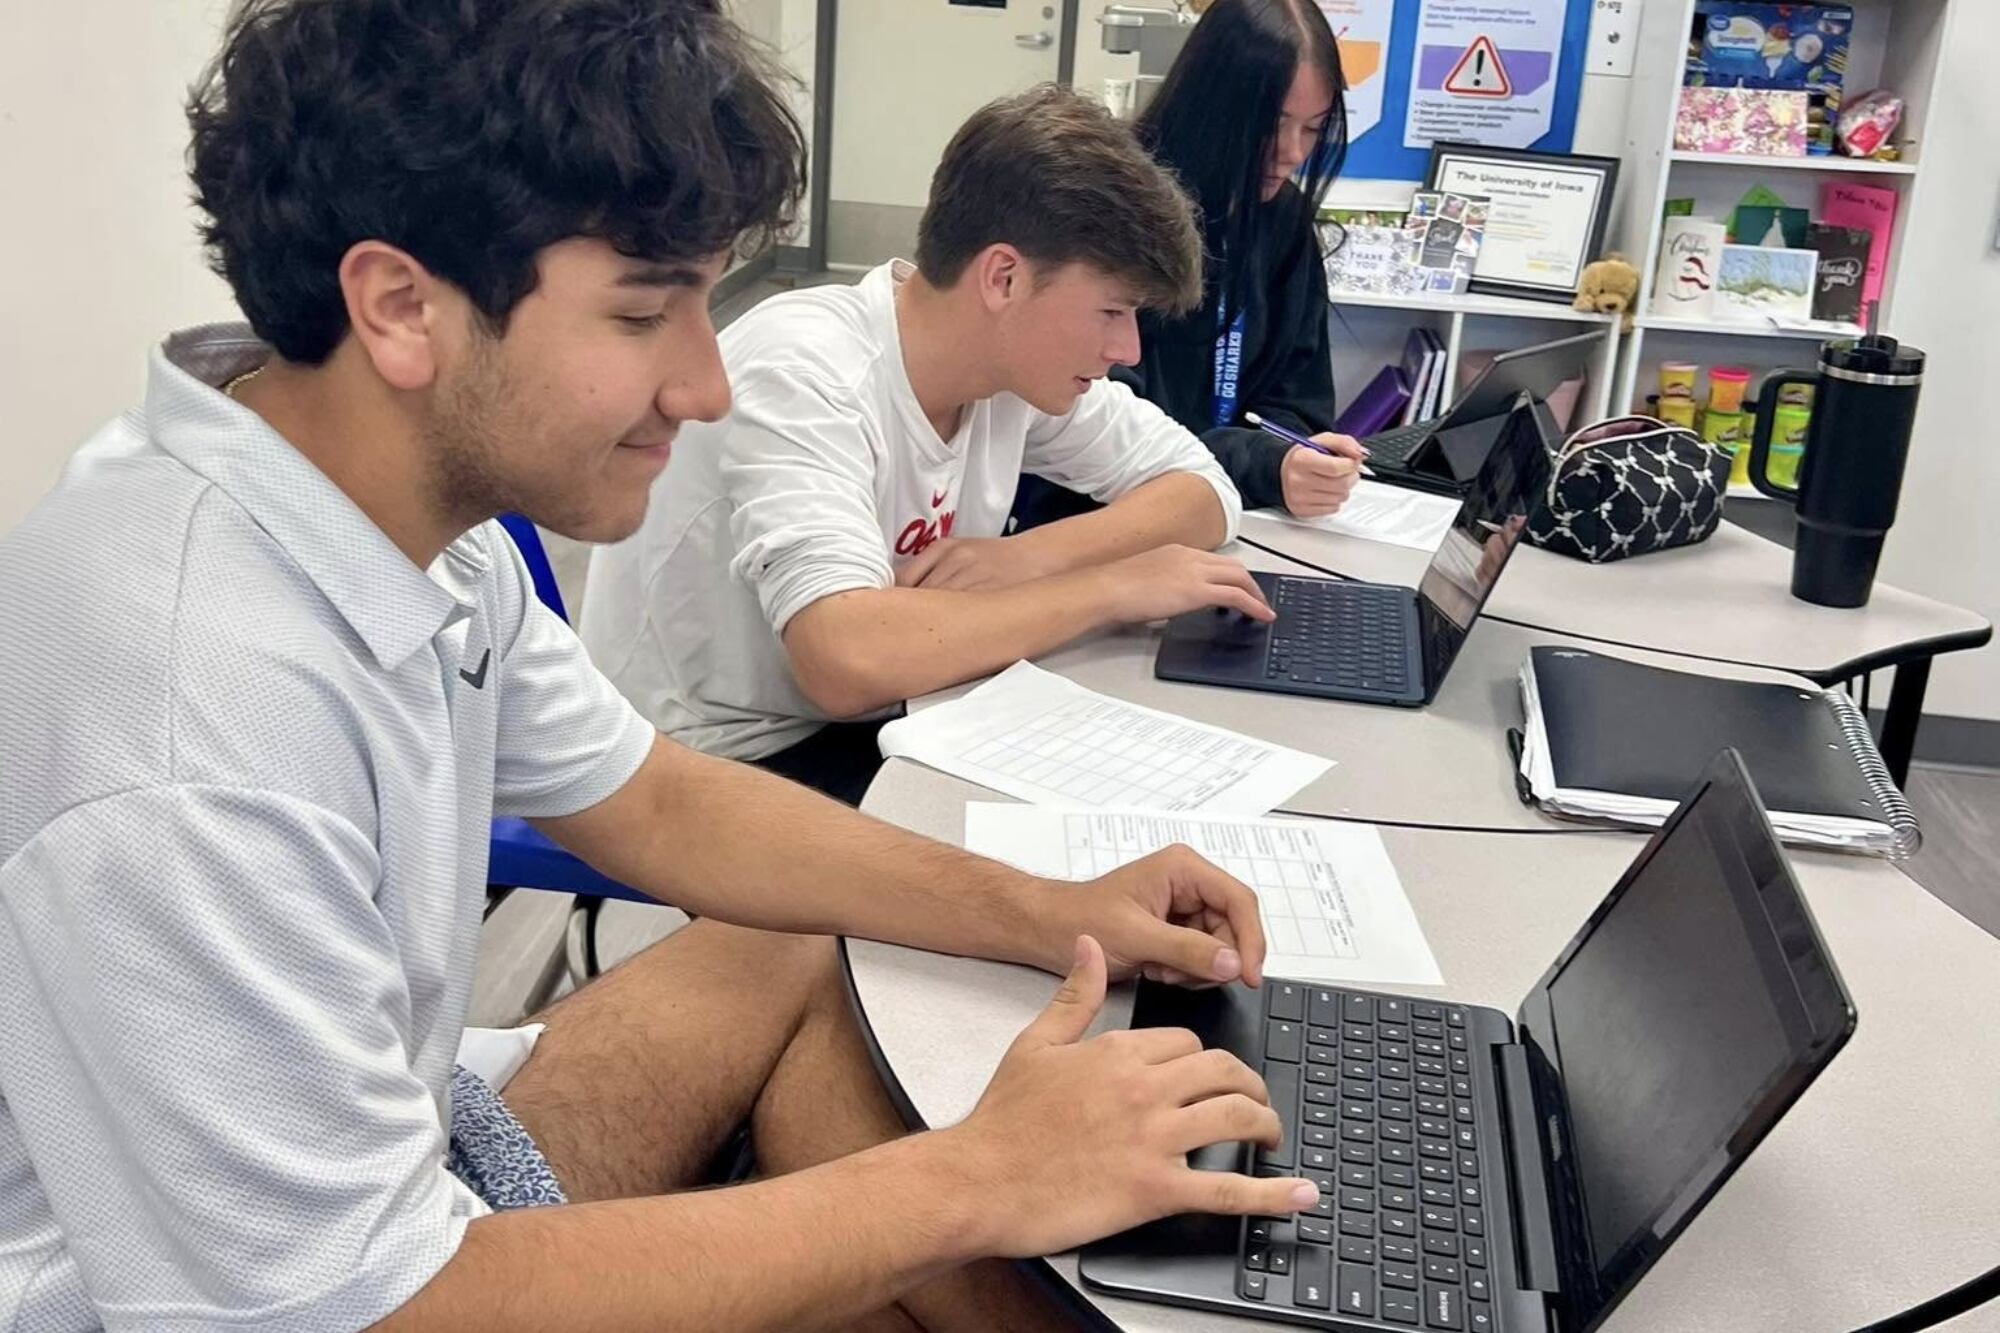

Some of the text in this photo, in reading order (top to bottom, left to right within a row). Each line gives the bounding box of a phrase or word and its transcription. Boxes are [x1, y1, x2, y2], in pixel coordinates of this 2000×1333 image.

[1457, 170, 1584, 192] The University of Iowa
[1350, 252, 1384, 262] THANK
[1224, 331, 1242, 381] SHARKS
[1221, 382, 1237, 398] GO
